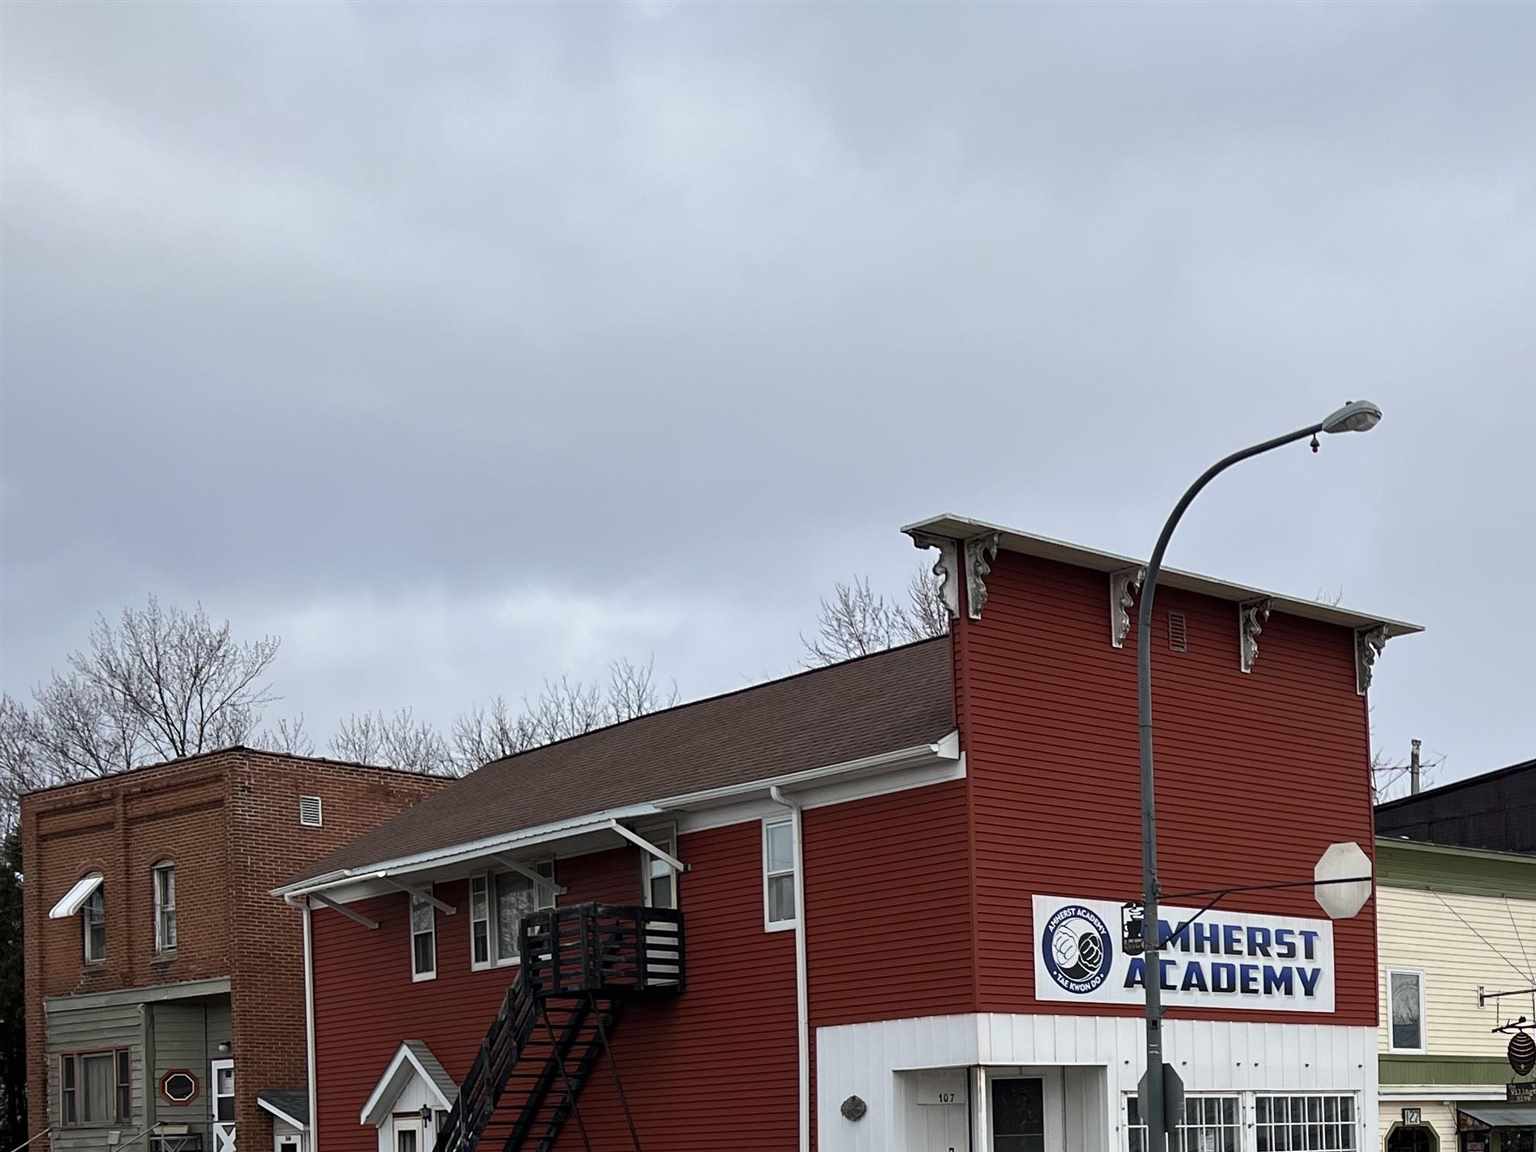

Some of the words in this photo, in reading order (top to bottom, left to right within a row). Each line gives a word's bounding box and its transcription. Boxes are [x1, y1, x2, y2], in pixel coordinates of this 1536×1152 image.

[1048, 908, 1076, 932] AMHERST
[1076, 908, 1107, 935] ACADEMY
[1138, 919, 1319, 959] MHERST
[1057, 974, 1069, 988] TAE
[1069, 982, 1091, 992] KWON
[1091, 977, 1101, 988] DO
[1123, 958, 1321, 996] ACADEMY
[939, 1093, 955, 1103] 107
